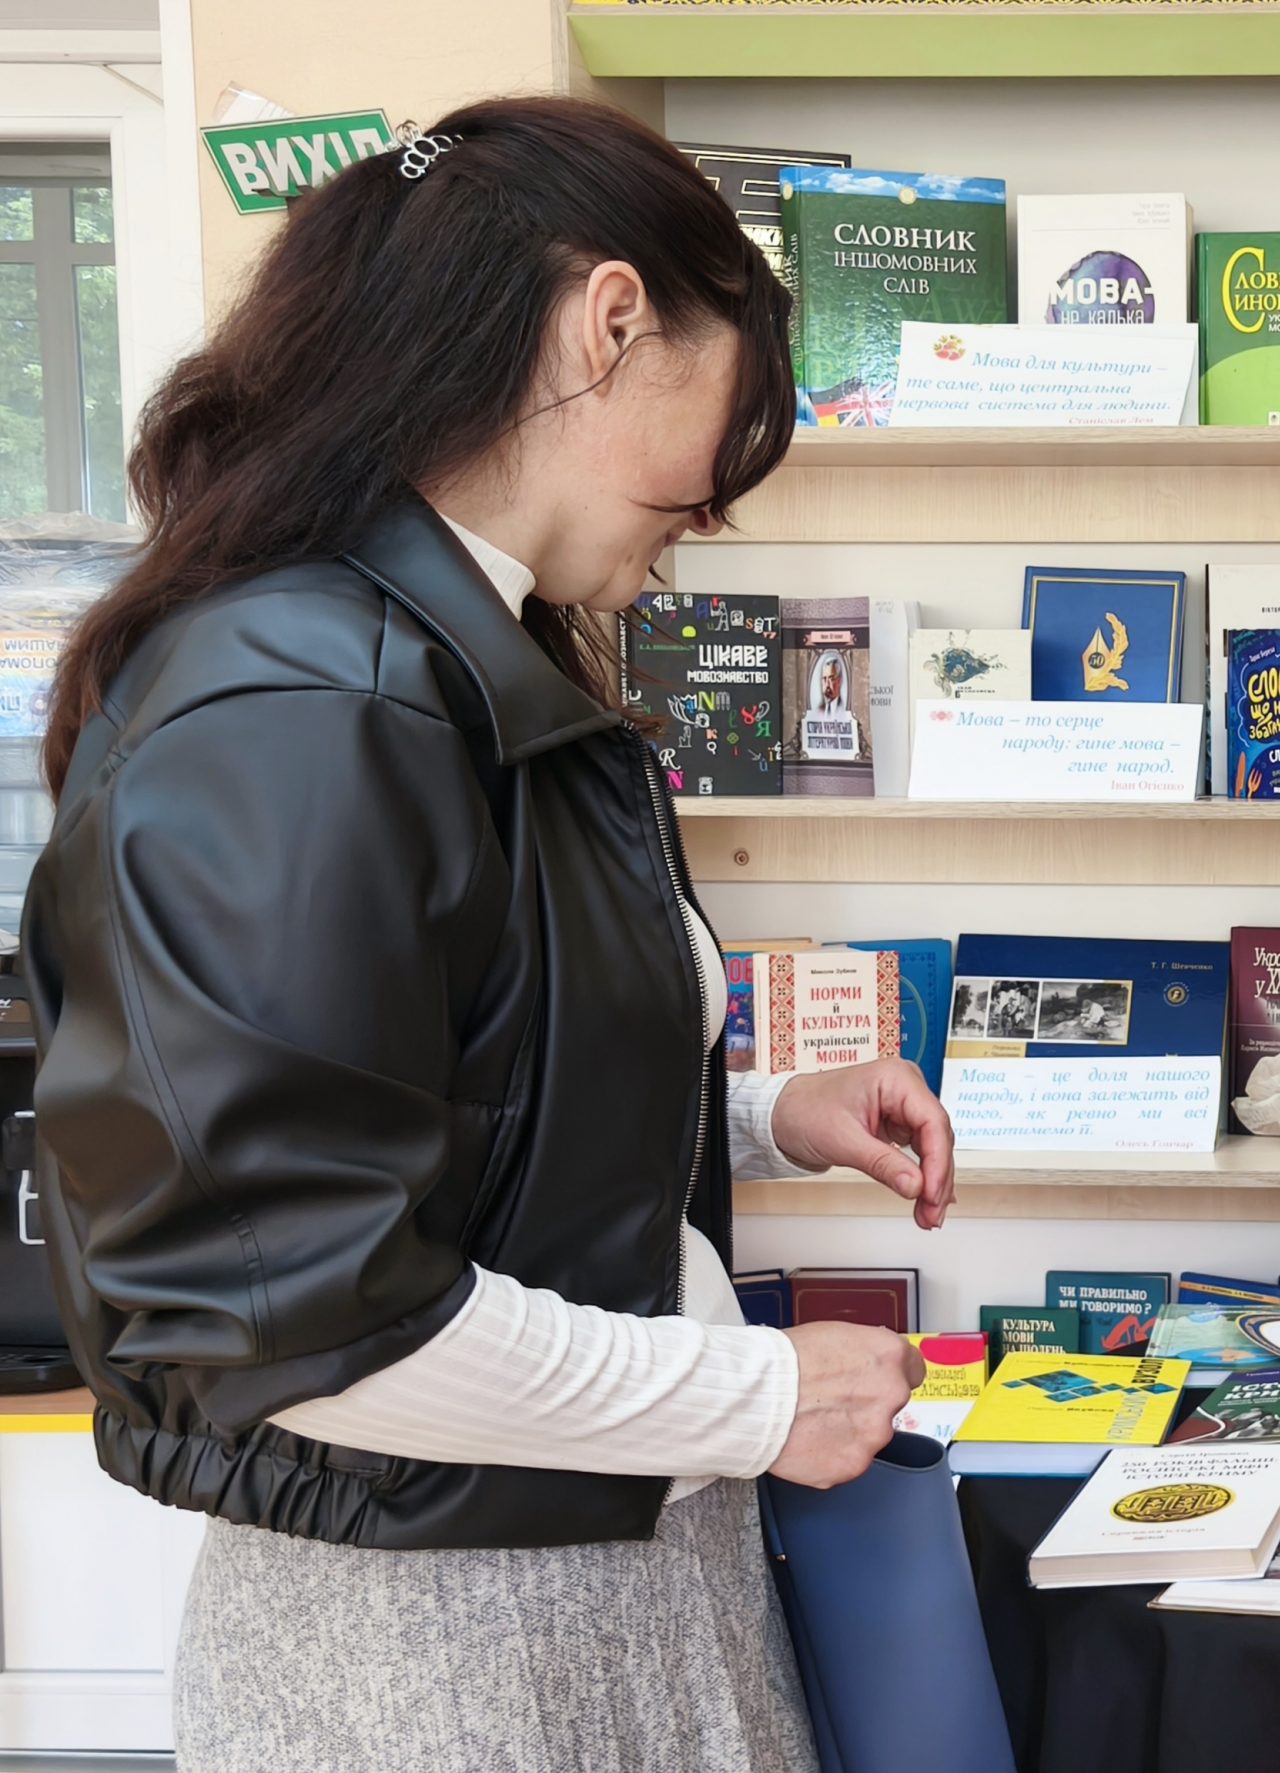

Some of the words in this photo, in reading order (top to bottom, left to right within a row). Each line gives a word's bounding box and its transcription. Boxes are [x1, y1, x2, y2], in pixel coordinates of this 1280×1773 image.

[834, 224, 976, 252] СЛОВНИК
[834, 252, 977, 275] ІНШОМОВНИХ
[884, 278, 930, 295] СЛІВ
[972, 352, 1020, 369] Мова
[1025, 355, 1056, 371] для
[1062, 360, 1152, 376] культури
[906, 376, 933, 389] те
[936, 378, 984, 393] саме,
[989, 381, 1016, 394] що
[1020, 382, 1132, 395] центральна
[897, 399, 969, 411] нервова
[977, 400, 1056, 411] система
[1061, 398, 1093, 411] для
[1097, 399, 1171, 411] людини.
[698, 644, 769, 670] ЦІКАВЕ
[686, 670, 769, 684] МОВОЗНАВСТВО
[956, 711, 1004, 727] Мова
[1025, 716, 1052, 727] то
[1056, 716, 1104, 731] серце
[1002, 734, 1072, 753] народу:
[1076, 739, 1116, 750] гине
[1119, 739, 1165, 750] мова
[1067, 761, 1108, 773] гине
[1116, 758, 1175, 776] народ.
[1111, 780, 1136, 791] Іван
[1138, 780, 1185, 793] Огієнко
[1171, 963, 1213, 971] Шевченко
[810, 986, 862, 1001] НОРМИ
[833, 1002, 840, 1013] й
[802, 1015, 871, 1031] КУЛЬТУРА
[803, 1034, 870, 1050] української
[816, 1050, 858, 1064] МОВИ
[960, 1068, 1006, 1082] Мова
[1052, 1071, 1072, 1084] це
[1088, 1067, 1128, 1082] доля
[1145, 1069, 1210, 1084] нашого
[958, 1089, 1023, 1105] народу,
[1041, 1090, 1082, 1101] вона
[1087, 1090, 1178, 1101] залежить
[1184, 1087, 1210, 1101] від
[1026, 1109, 1046, 1121] як
[1066, 1108, 1117, 1123] ревно
[1137, 1108, 1162, 1120] ми
[1184, 1107, 1208, 1119] всі
[1059, 1286, 1076, 1298] ЧИ
[1080, 1286, 1147, 1301] ПРАВИЛЬНО
[1059, 1300, 1078, 1309] МИ
[1002, 1318, 1056, 1333] КУЛЬТУРА
[1002, 1332, 1034, 1343] МОВИ
